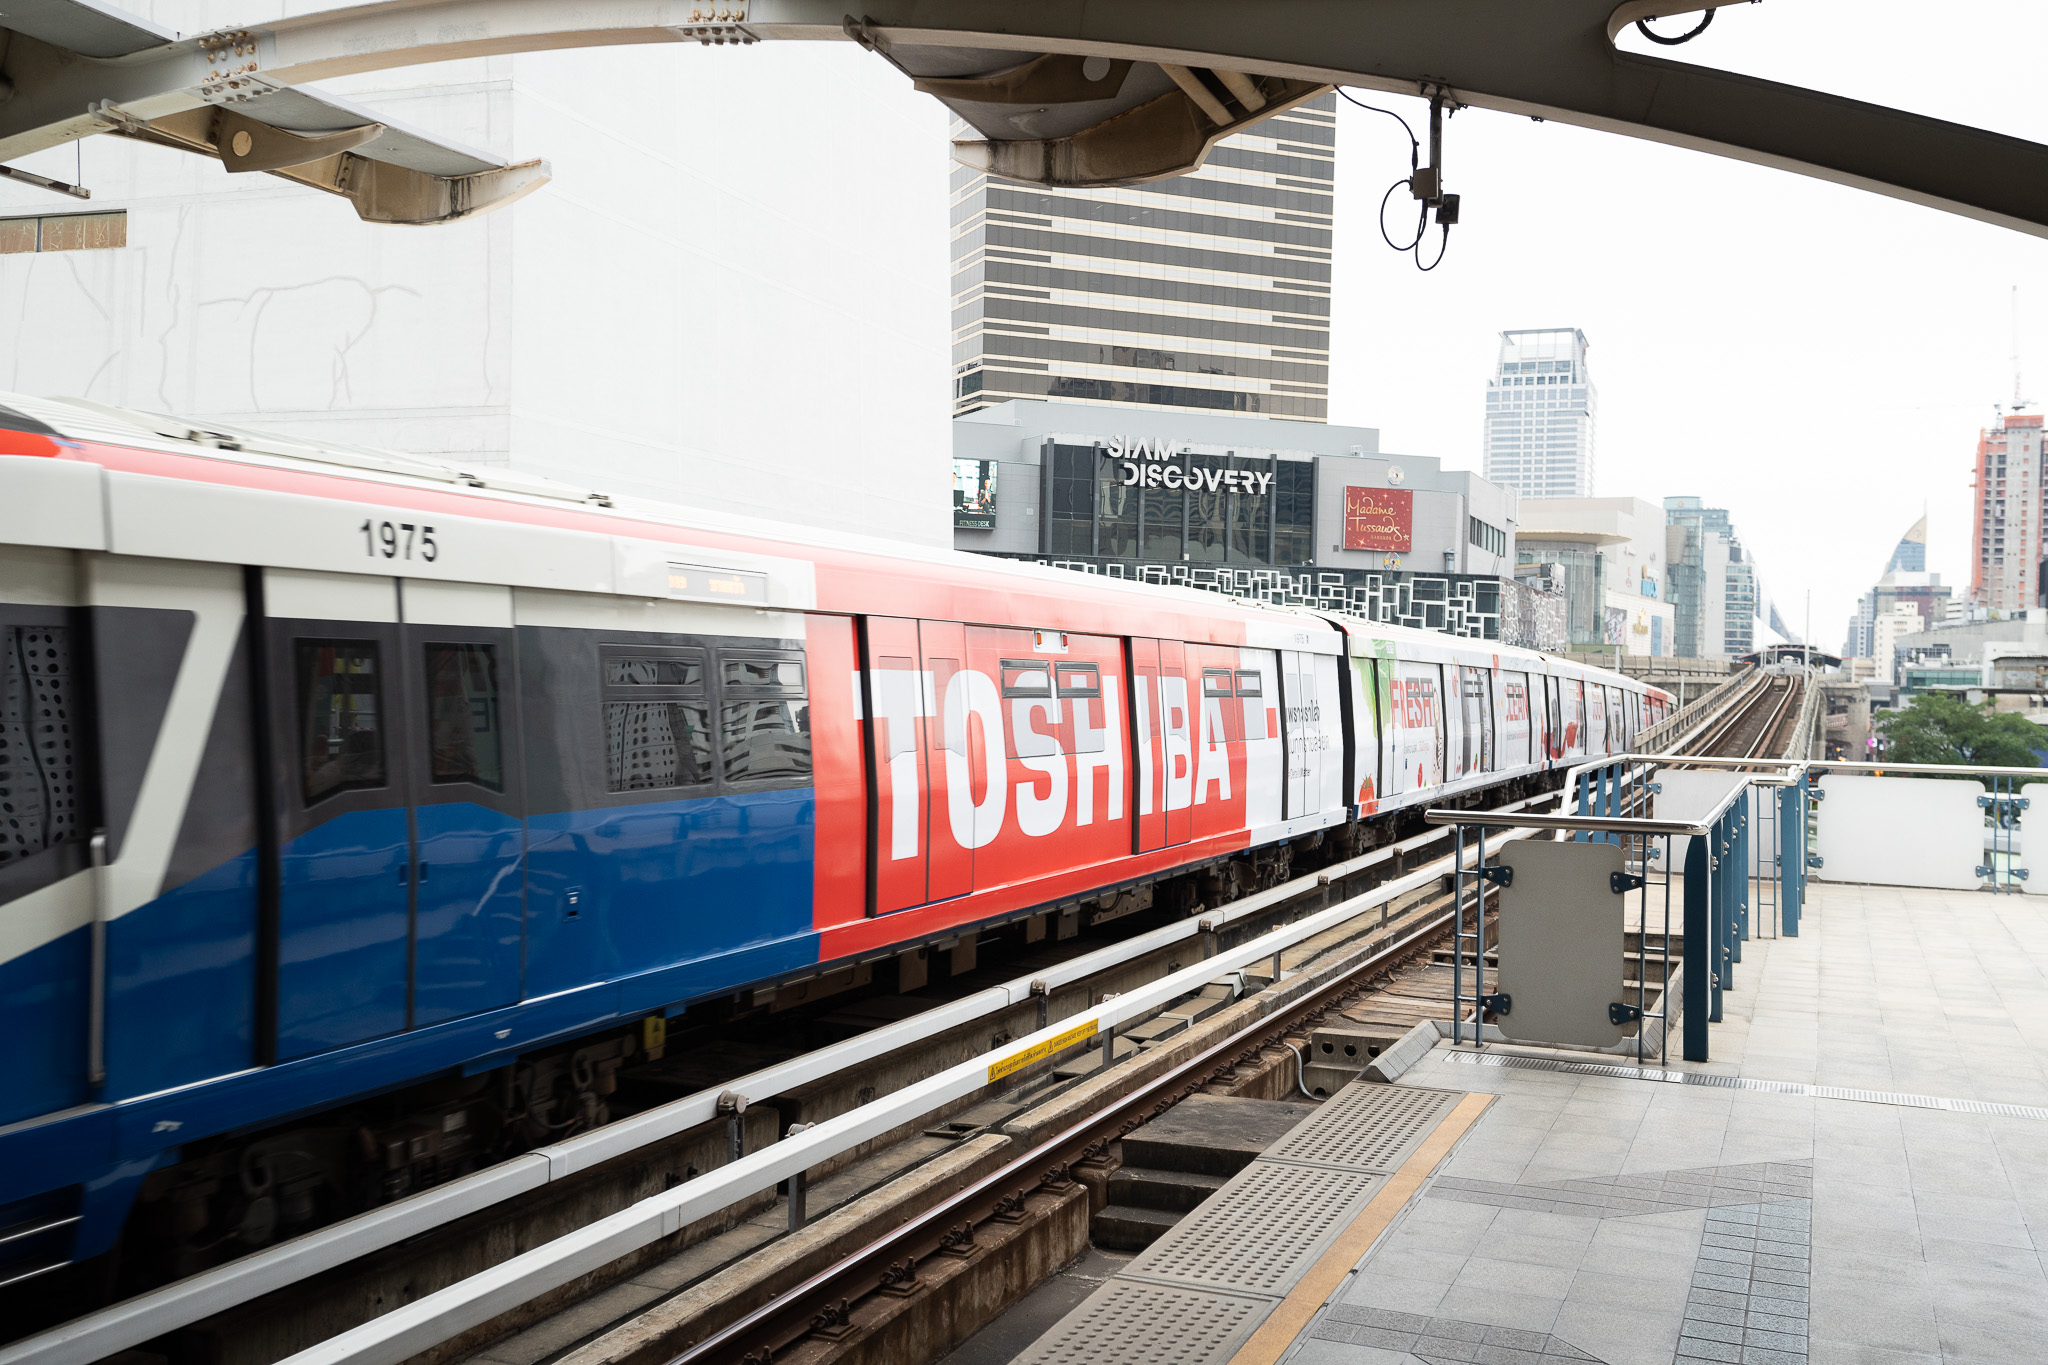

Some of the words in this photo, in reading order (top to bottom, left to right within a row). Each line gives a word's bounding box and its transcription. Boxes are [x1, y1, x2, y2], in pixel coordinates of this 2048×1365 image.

[1107, 434, 1177, 462] SIAM
[1123, 462, 1273, 495] DISCOVERY
[1347, 496, 1397, 516] Madame
[959, 519, 978, 528] FITNESS
[978, 520, 990, 528] DESK
[1348, 516, 1403, 542] Tussauds
[359, 518, 439, 562] 1975
[1389, 678, 1433, 730] FRESH
[851, 668, 1232, 861] TOSHIBA
